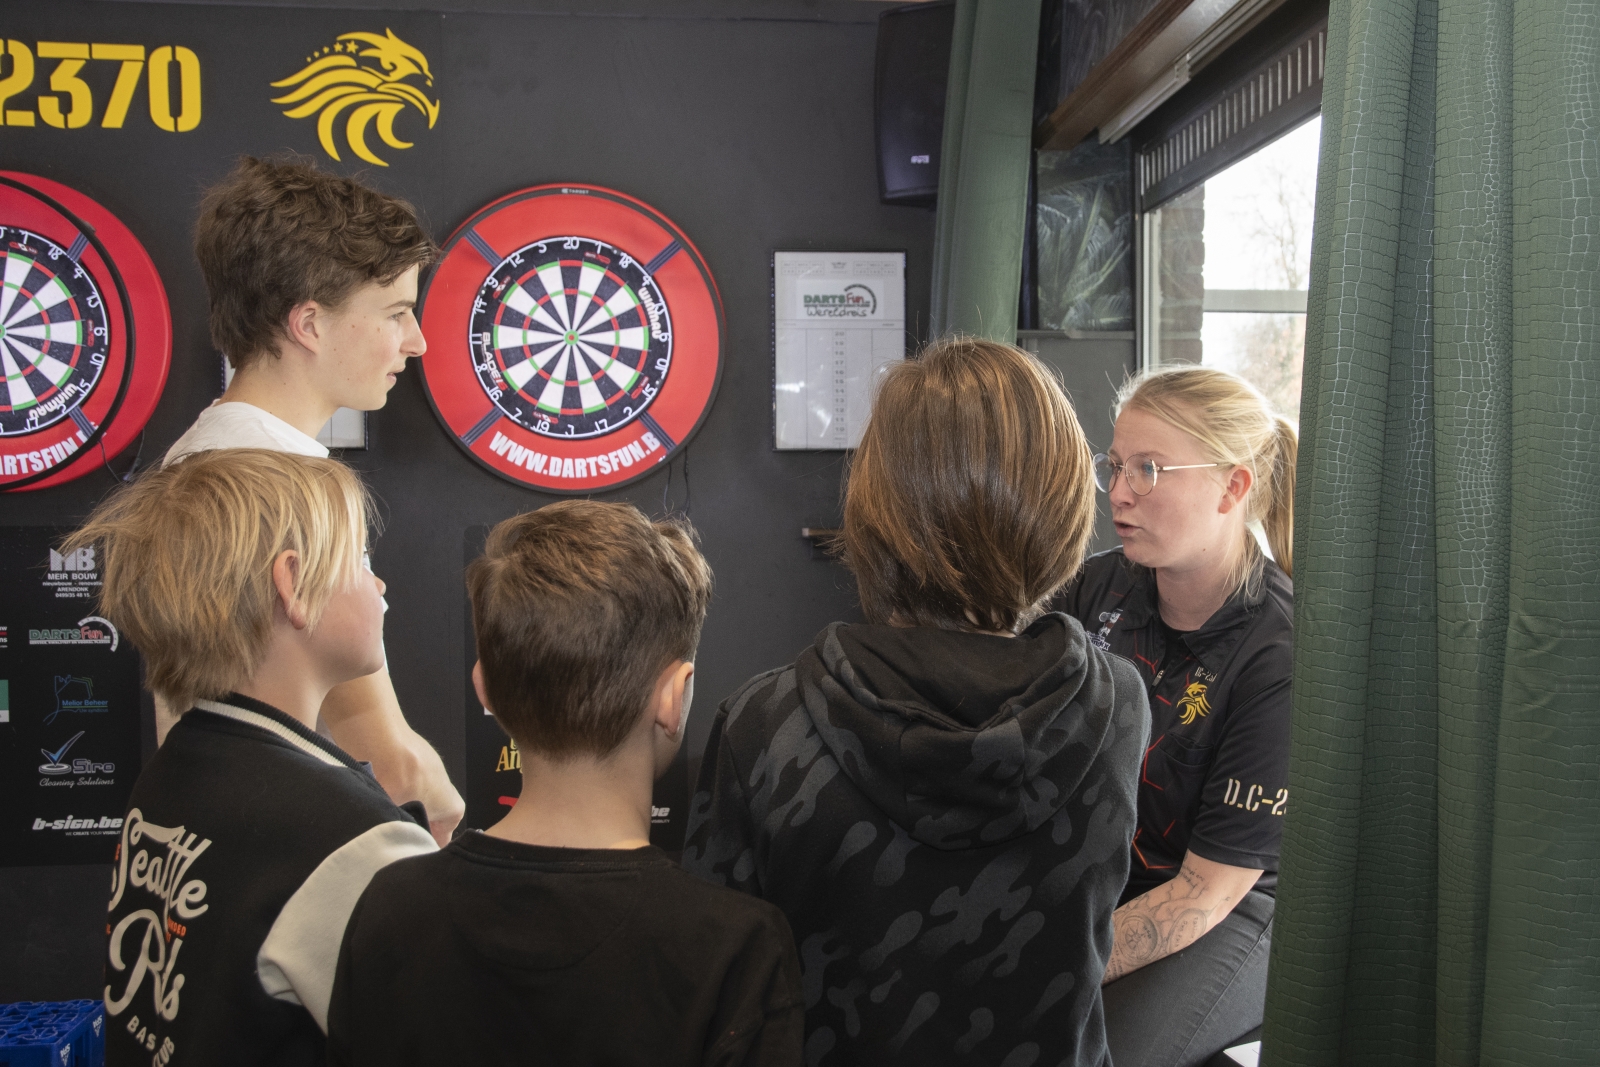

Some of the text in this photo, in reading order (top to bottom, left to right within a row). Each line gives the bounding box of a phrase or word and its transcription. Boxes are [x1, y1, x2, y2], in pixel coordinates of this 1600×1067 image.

[0, 38, 201, 132] 2370
[537, 240, 548, 254] 5
[563, 237, 580, 250] 20
[618, 252, 633, 270] 18
[486, 276, 499, 290] 9
[658, 332, 670, 343] 6
[475, 363, 488, 373] 8
[623, 406, 635, 418] 2
[489, 430, 662, 478] WWW.DARTSFUN.B
[73, 759, 115, 774] Siro
[39, 777, 115, 788] Cleaning Solutions
[1224, 778, 1288, 815] D.C-2
